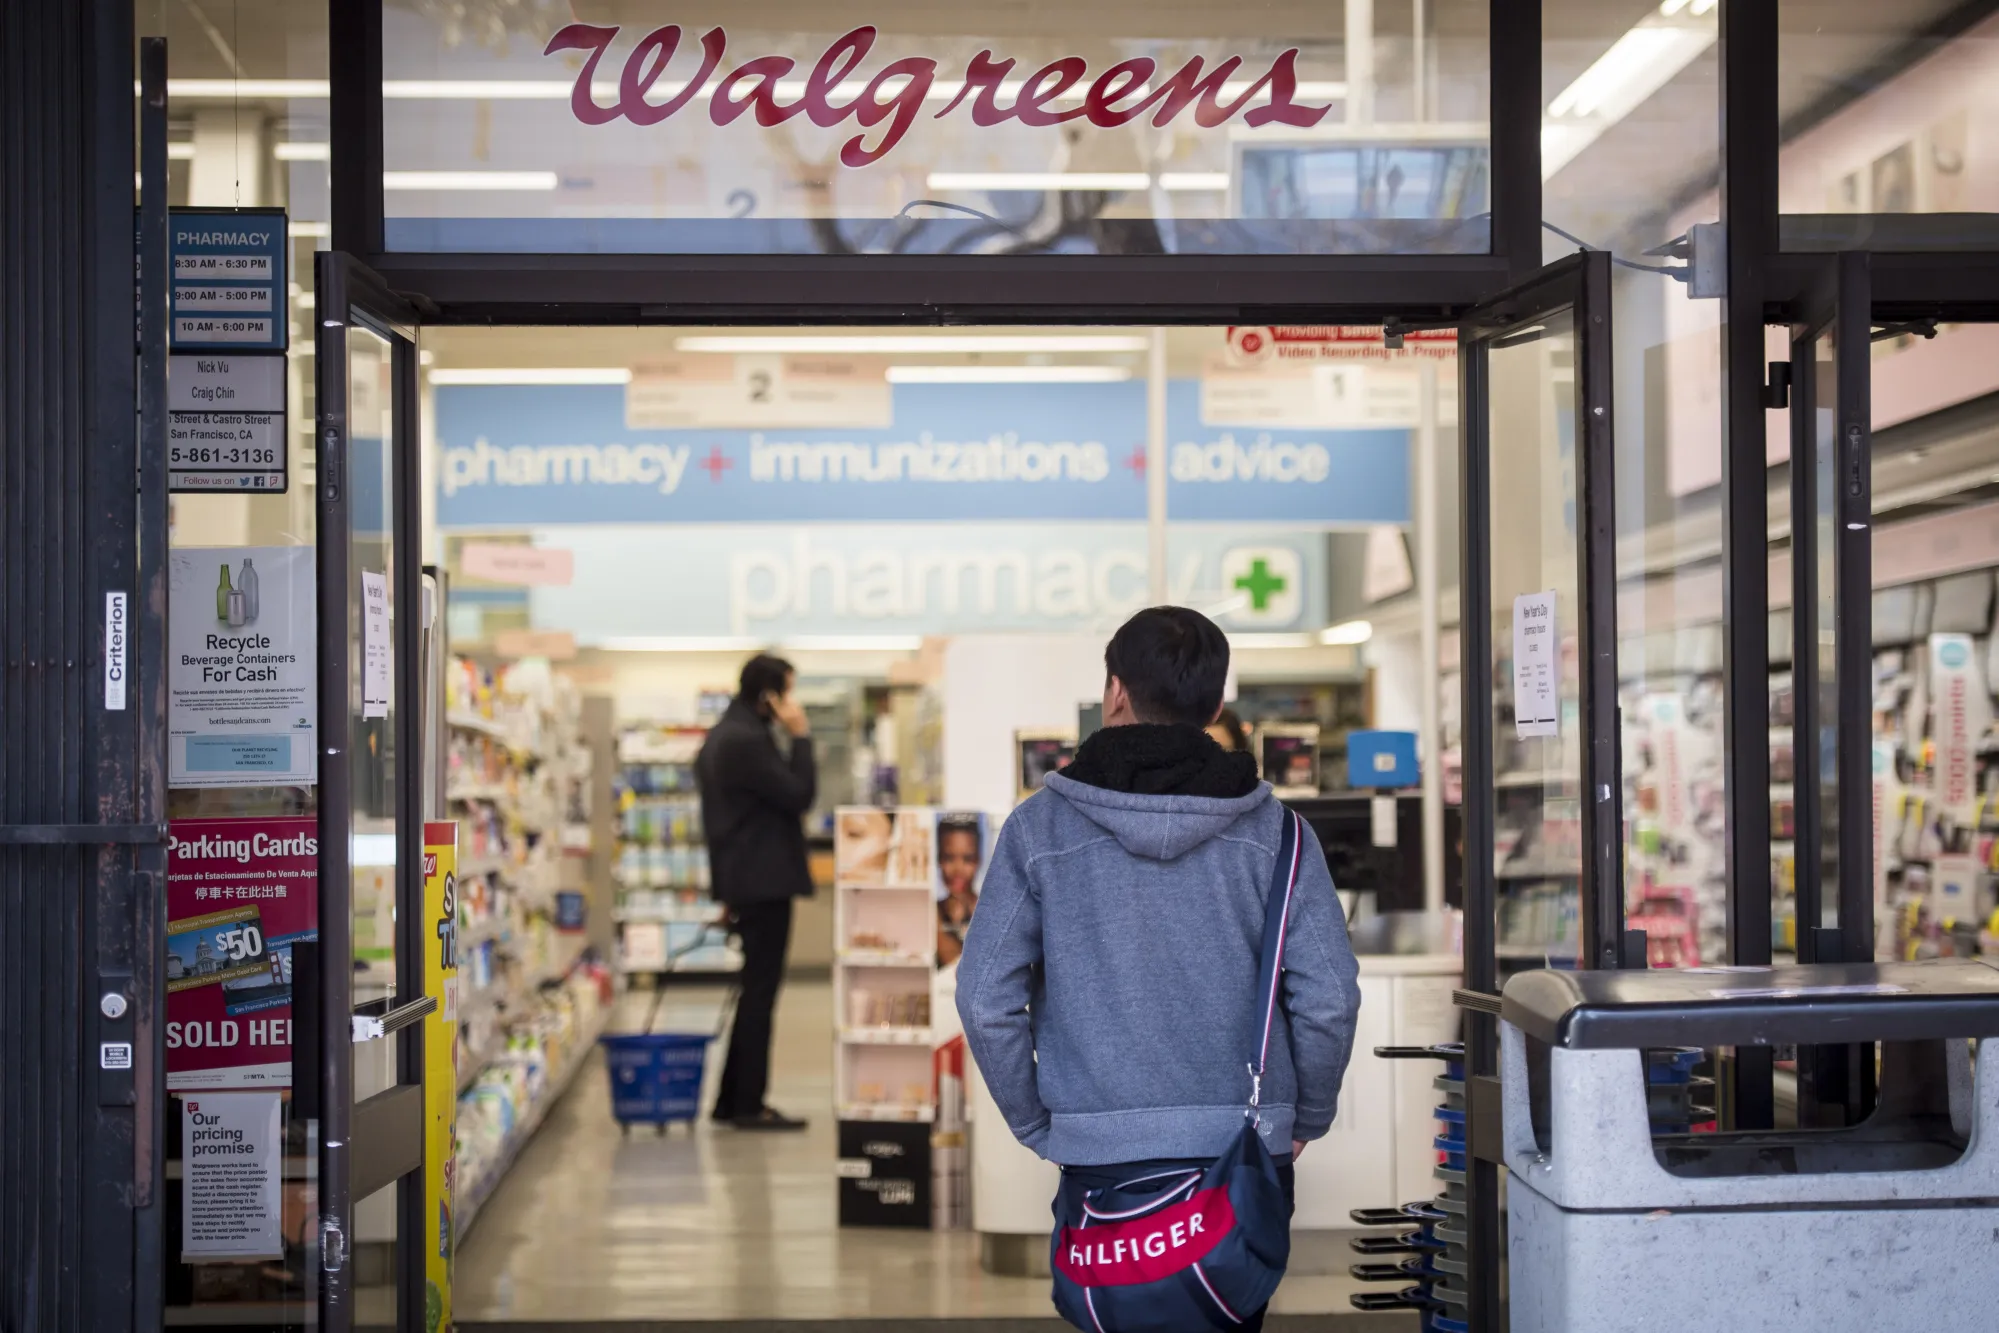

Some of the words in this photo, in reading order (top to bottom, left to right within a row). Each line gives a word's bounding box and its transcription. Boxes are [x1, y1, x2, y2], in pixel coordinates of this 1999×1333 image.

[543, 24, 1333, 168] Walgreens
[177, 232, 270, 246] PHARMACY
[175, 259, 197, 269] 8:30
[199, 259, 216, 269] AM
[225, 259, 247, 269] 6:30
[250, 259, 267, 269] PM
[175, 291, 197, 300] 9:00
[199, 291, 216, 300] AM
[225, 291, 247, 300] 5:00
[250, 291, 267, 300] PM
[181, 322, 194, 332] 10
[196, 322, 213, 332] AM
[222, 322, 245, 332] 6:00
[247, 322, 264, 332] PM
[1278, 346, 1316, 358] Video
[1321, 346, 1391, 360] Recording
[1413, 346, 1458, 360] Progr
[197, 361, 215, 373] Nick
[217, 361, 229, 373] Vu
[748, 370, 772, 403] 2
[1332, 373, 1345, 400] 1
[191, 387, 214, 401] Craig
[216, 387, 235, 399] Chin
[174, 414, 202, 425] Street
[203, 414, 210, 425] &
[212, 414, 242, 425] Castro
[244, 414, 272, 425] Street
[170, 429, 188, 440] San
[190, 429, 237, 441] Francisco,
[239, 429, 253, 440] CA
[170, 448, 274, 464] 5-861-3136
[440, 435, 690, 495] pharmacy
[750, 432, 1110, 483] immunizations
[1171, 433, 1330, 484] advice
[183, 476, 208, 486] Follow
[209, 478, 218, 486] us
[220, 478, 235, 486] on
[109, 595, 123, 682] Criterion
[206, 633, 270, 652] Recycle
[181, 655, 233, 667] Beverage
[236, 653, 296, 665] Containers
[203, 667, 231, 682] For
[209, 717, 271, 725] bottlesandcans.com
[168, 834, 250, 863] Parking
[253, 832, 318, 857] Cards
[168, 873, 192, 881] arjetas
[194, 872, 203, 880] de
[205, 871, 265, 880] Estacionamiento
[266, 870, 277, 879] De
[278, 870, 299, 878] Venta
[195, 885, 287, 900] 停車卡在此出售
[235, 910, 253, 920] Agency
[215, 926, 263, 961] $50
[168, 983, 179, 991] San
[203, 974, 221, 985] Parking
[250, 965, 263, 974] Card
[235, 1006, 245, 1014] San
[246, 1002, 268, 1012] Francisco
[166, 1021, 239, 1048] SOLD
[249, 1019, 292, 1046] HE
[192, 1112, 220, 1126] Our
[192, 1127, 243, 1143] pricing
[192, 1141, 254, 1157] promise
[1069, 1212, 1205, 1267] HILFIGER
